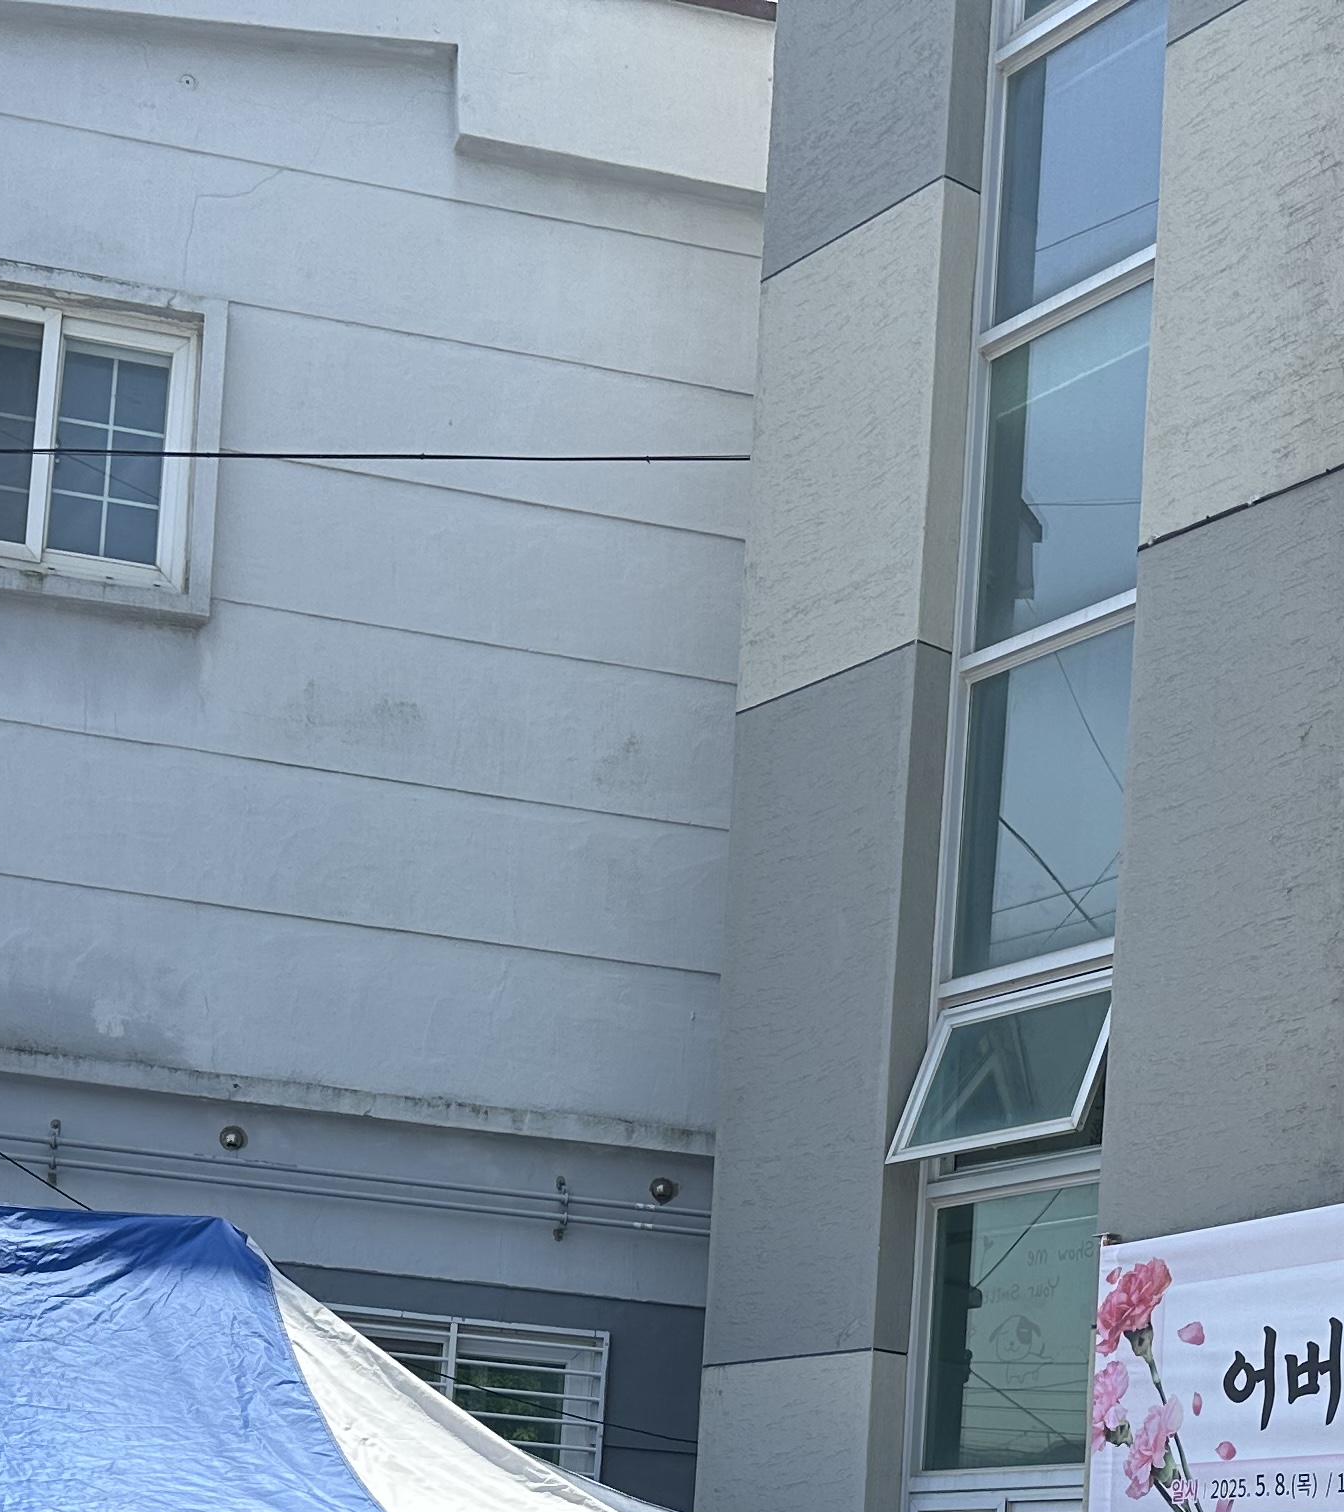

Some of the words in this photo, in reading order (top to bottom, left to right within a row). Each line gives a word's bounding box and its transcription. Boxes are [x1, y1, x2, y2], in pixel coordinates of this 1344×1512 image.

[1171, 1479, 1199, 1503] 일시
[1210, 1478, 1251, 1499] 2025.
[1255, 1474, 1270, 1497] 5.
